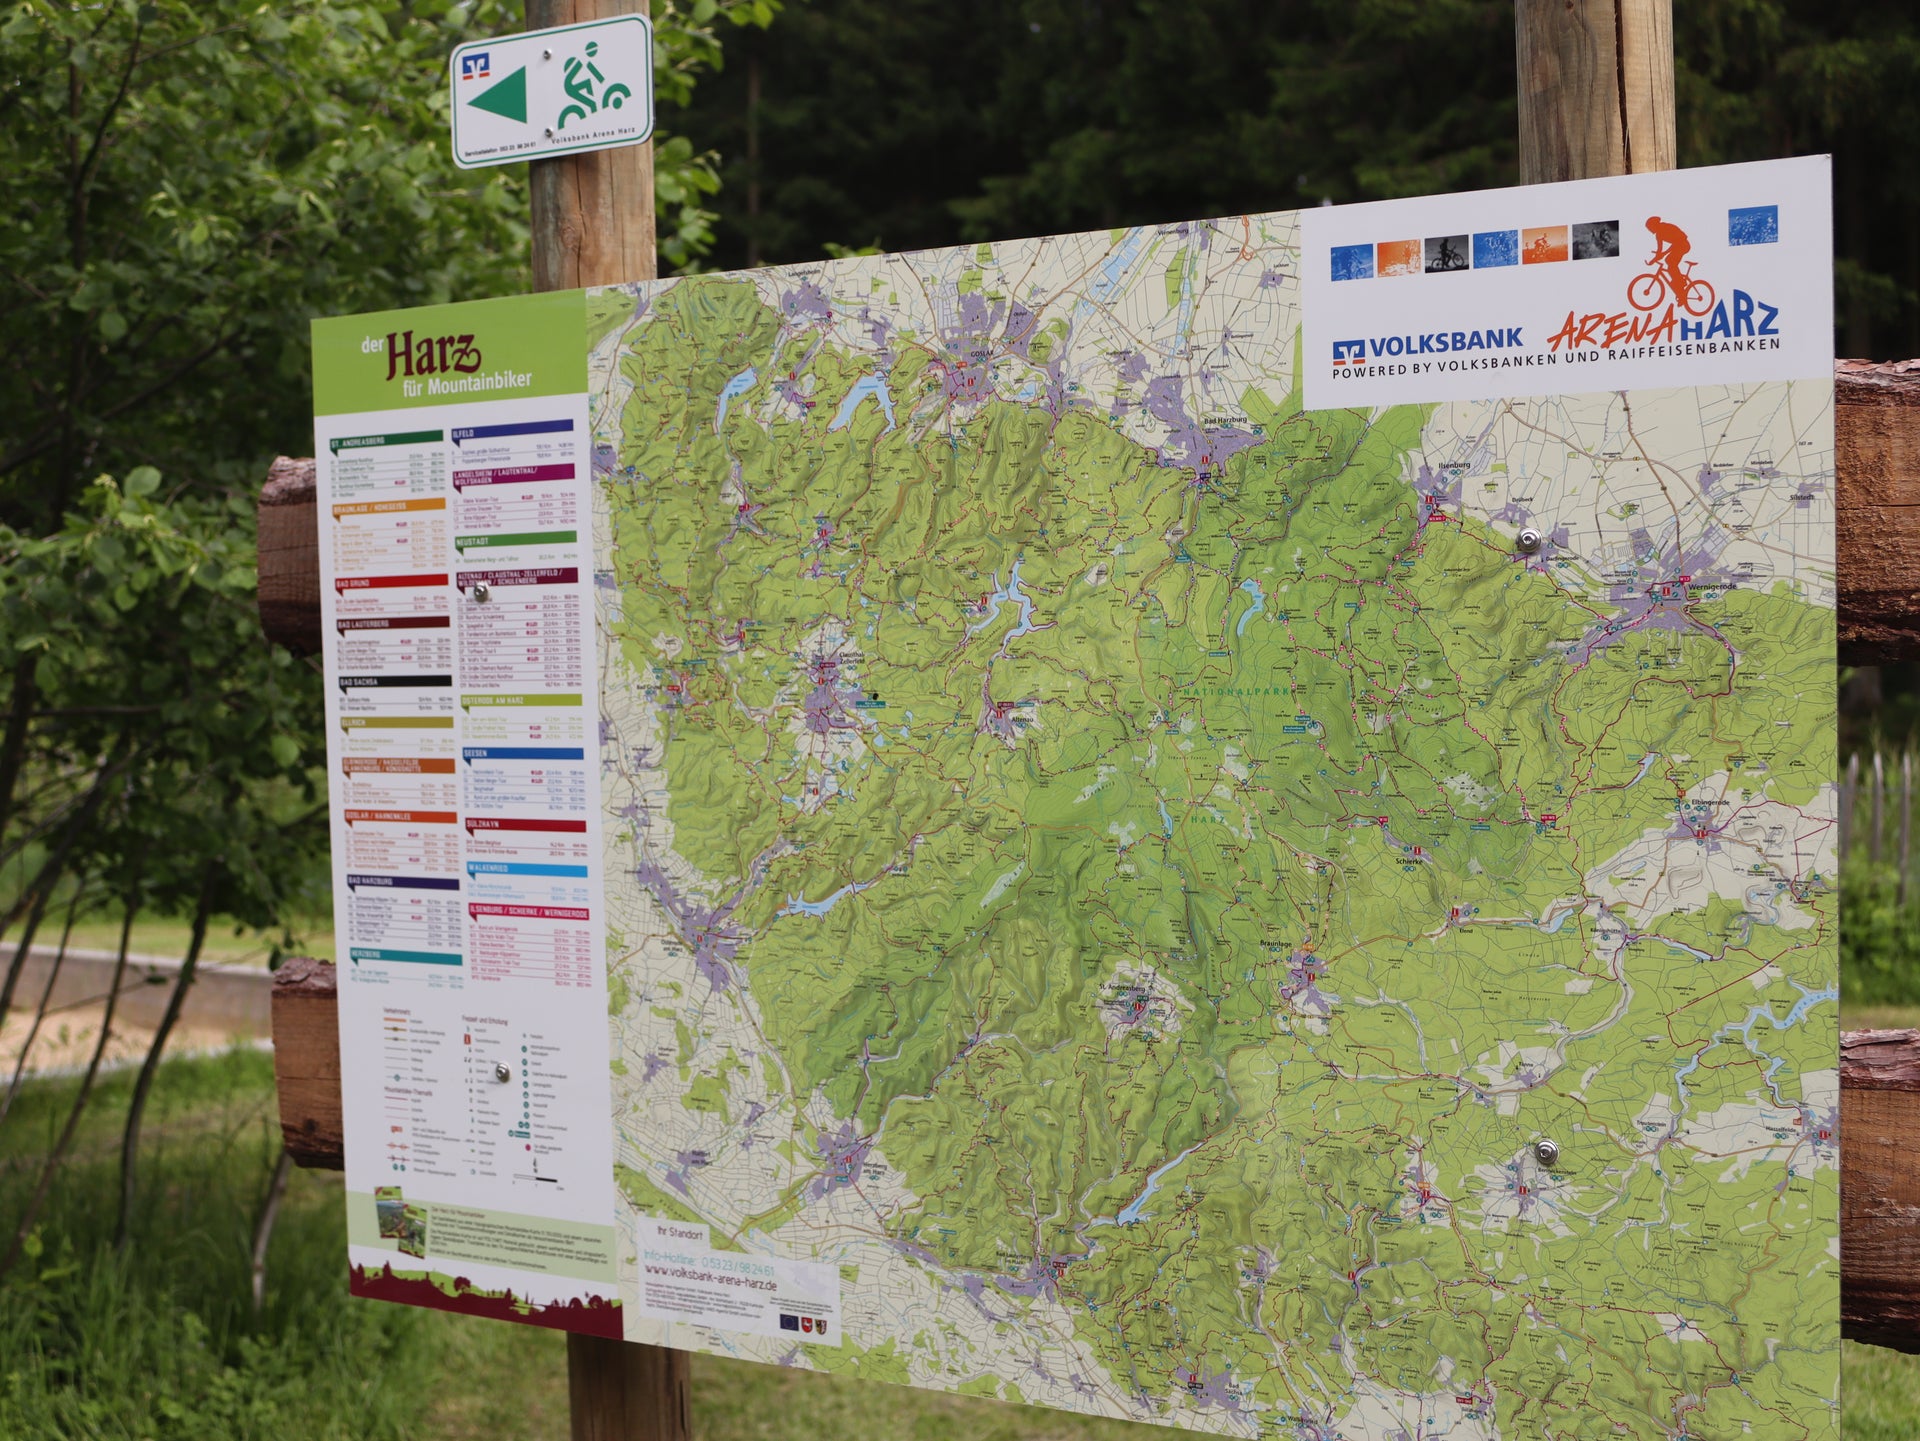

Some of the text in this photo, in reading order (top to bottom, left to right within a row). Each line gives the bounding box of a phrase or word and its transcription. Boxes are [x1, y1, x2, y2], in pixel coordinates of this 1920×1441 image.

[593, 129, 615, 138] Arena
[618, 127, 635, 135] Harz
[1680, 289, 1780, 342] HARZ
[1370, 327, 1524, 358] VOLKSBANK
[361, 330, 482, 381] der Harz
[1333, 338, 1781, 380] POWERED BY VOLKSBANKEN UND RAIFFEISENBANKEN
[403, 371, 532, 398] für Mountainbiker
[1204, 416, 1248, 425] Bad Harzburg
[1438, 461, 1471, 469] Ilsenburg
[1688, 583, 1737, 592] Wernigerode
[1183, 687, 1290, 697] NATIONALPARK
[1191, 815, 1225, 824] HARZ
[1395, 857, 1423, 866] Schierke
[1260, 939, 1292, 948] Braunlage
[1107, 983, 1146, 993] Andreasberg
[657, 1225, 703, 1241] Ihr Standort
[645, 1264, 778, 1292] www.volksbank-arena-harz.de
